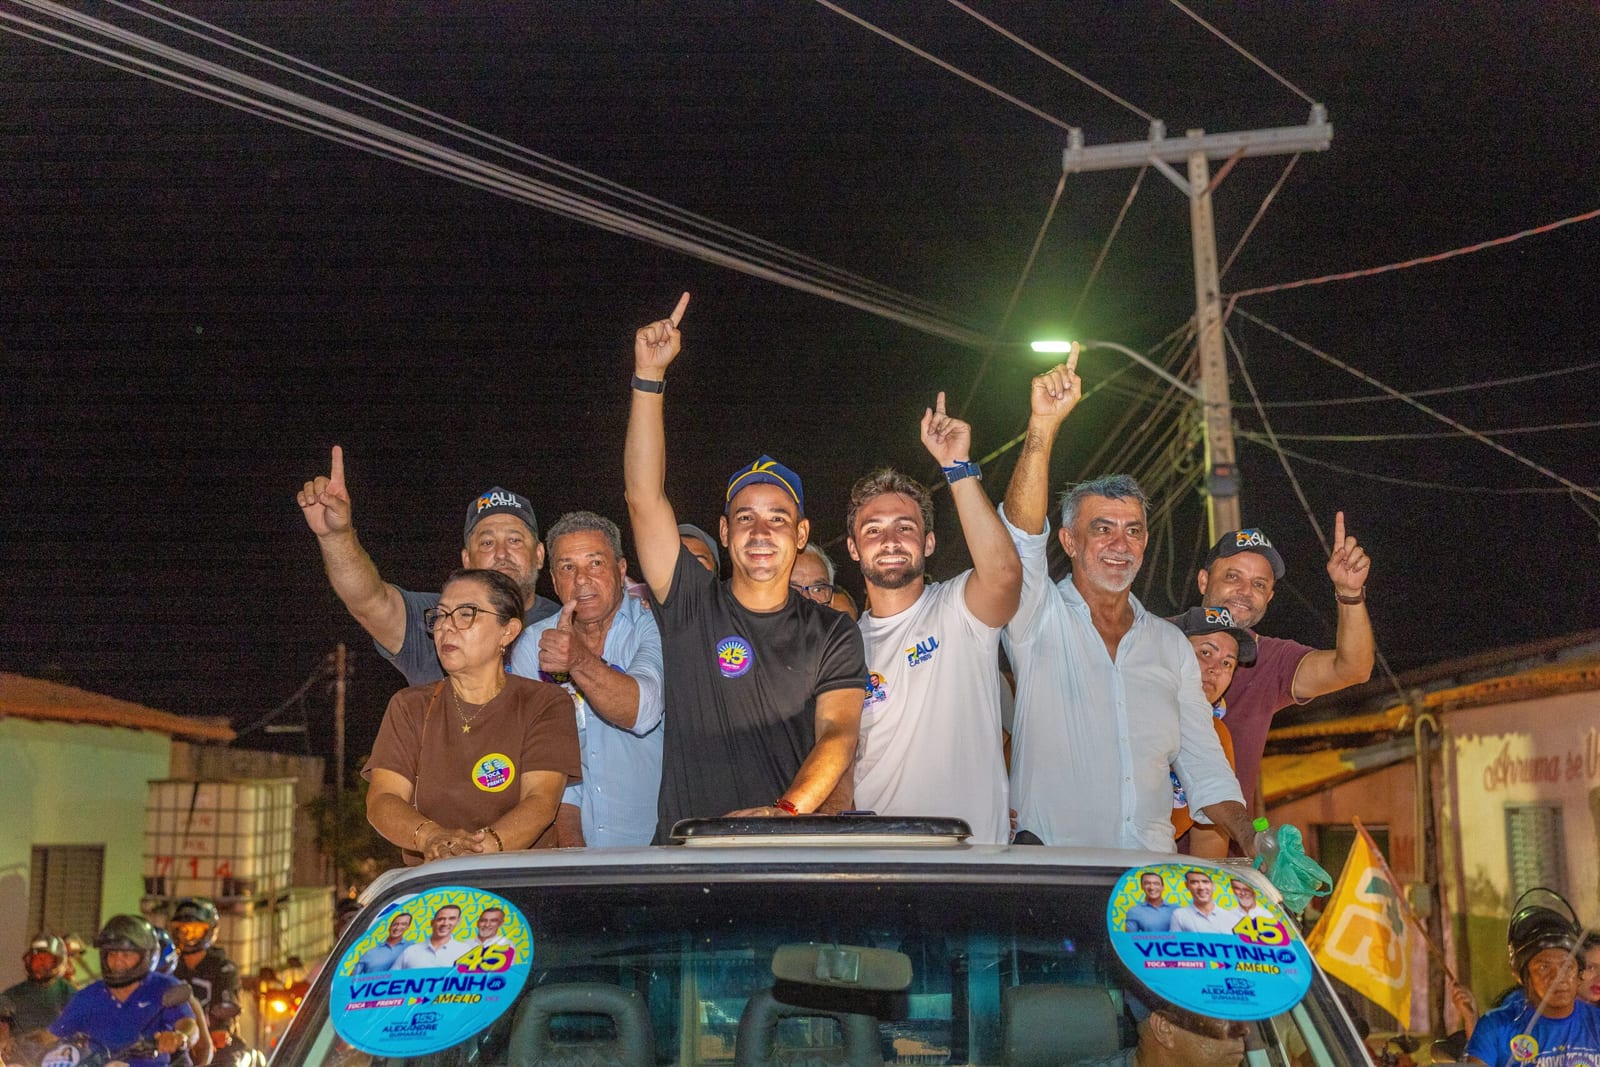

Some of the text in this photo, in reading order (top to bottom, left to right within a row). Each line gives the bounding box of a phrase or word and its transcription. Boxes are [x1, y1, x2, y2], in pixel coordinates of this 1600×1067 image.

[720, 648, 744, 665] 45
[1233, 915, 1283, 945] 45
[456, 944, 508, 971] 45
